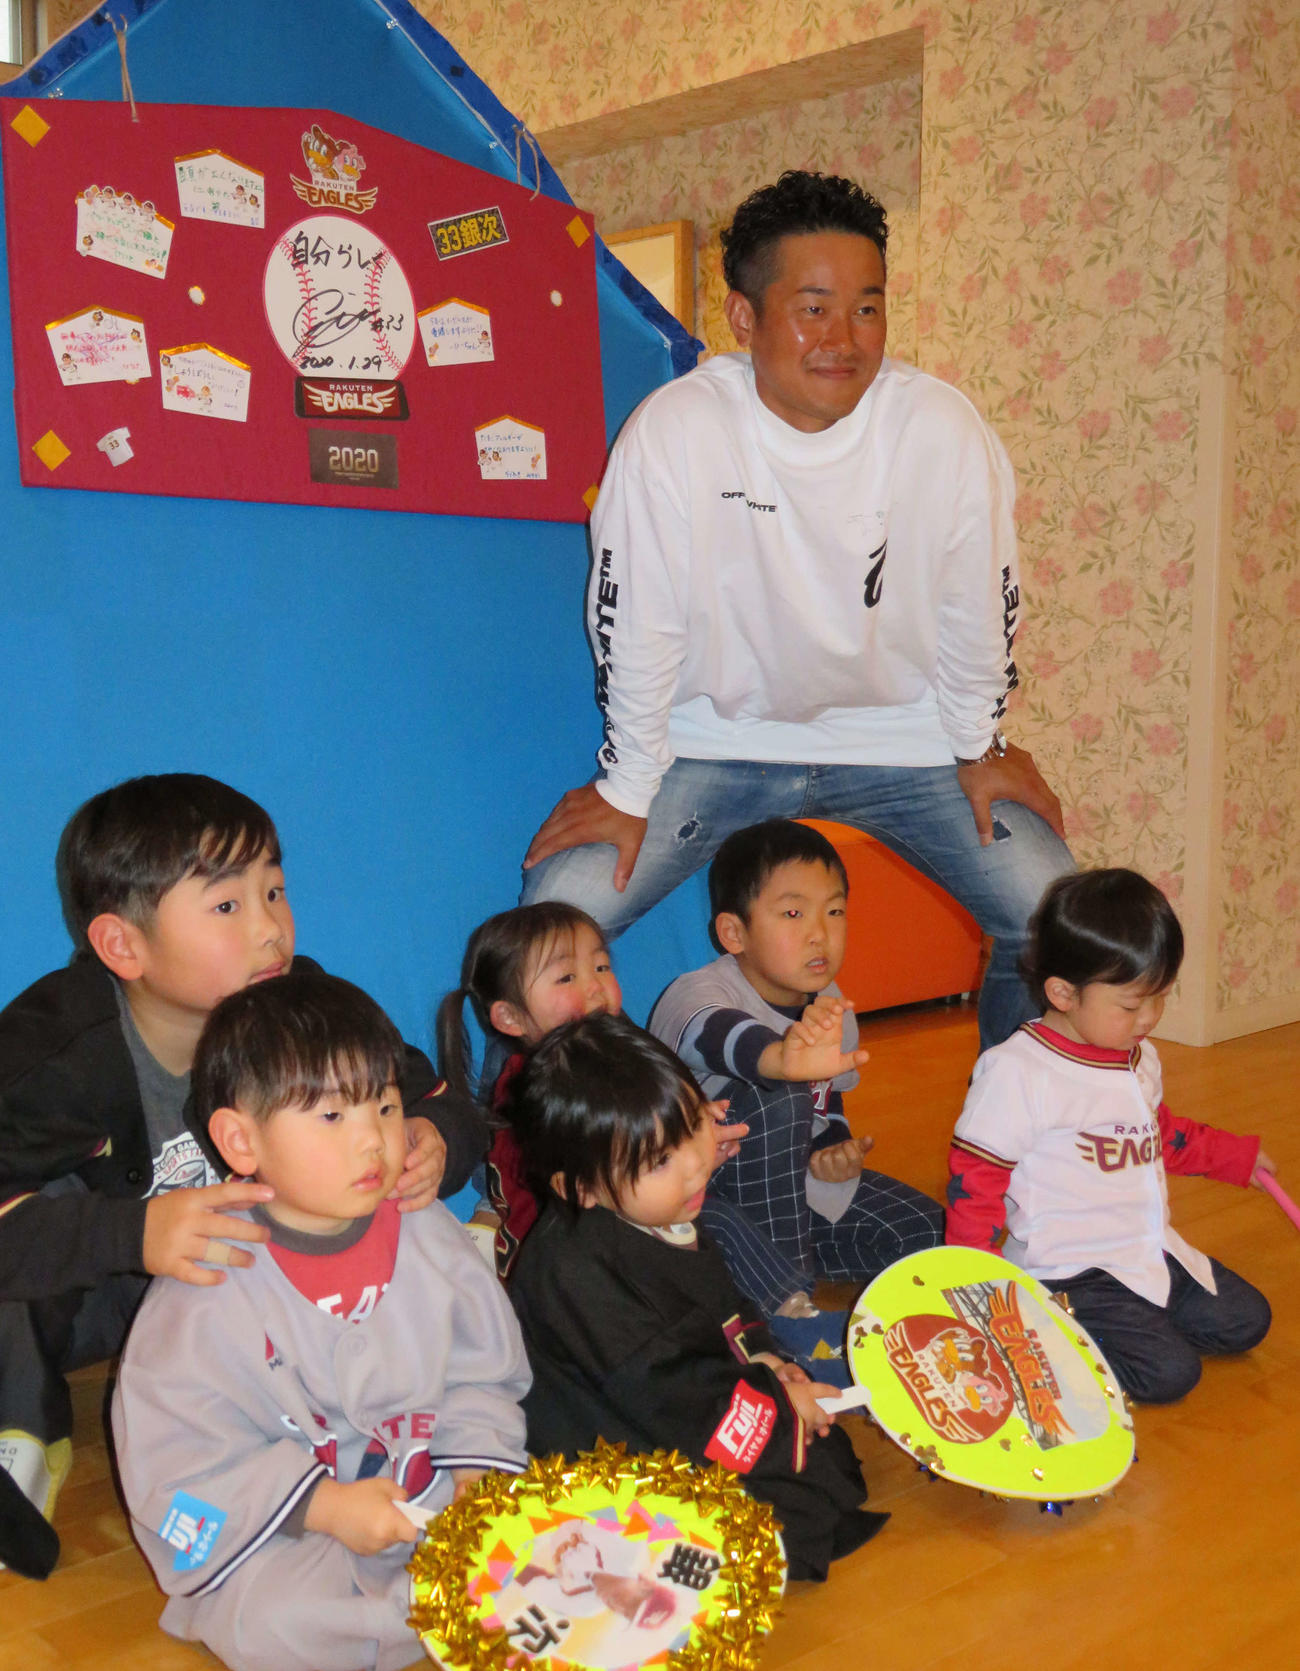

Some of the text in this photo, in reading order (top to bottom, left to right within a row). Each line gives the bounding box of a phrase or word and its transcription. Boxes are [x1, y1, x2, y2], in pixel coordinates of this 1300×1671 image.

[297, 178, 371, 213] EAGLES
[314, 181, 355, 192] RAKUTEN
[311, 388, 391, 414] EAGLES
[329, 384, 373, 392] RAKUTEN
[328, 446, 379, 473] 2020
[721, 491, 746, 499] OFF
[988, 1291, 1070, 1431] EAGLES
[885, 1335, 968, 1435] EAGLES
